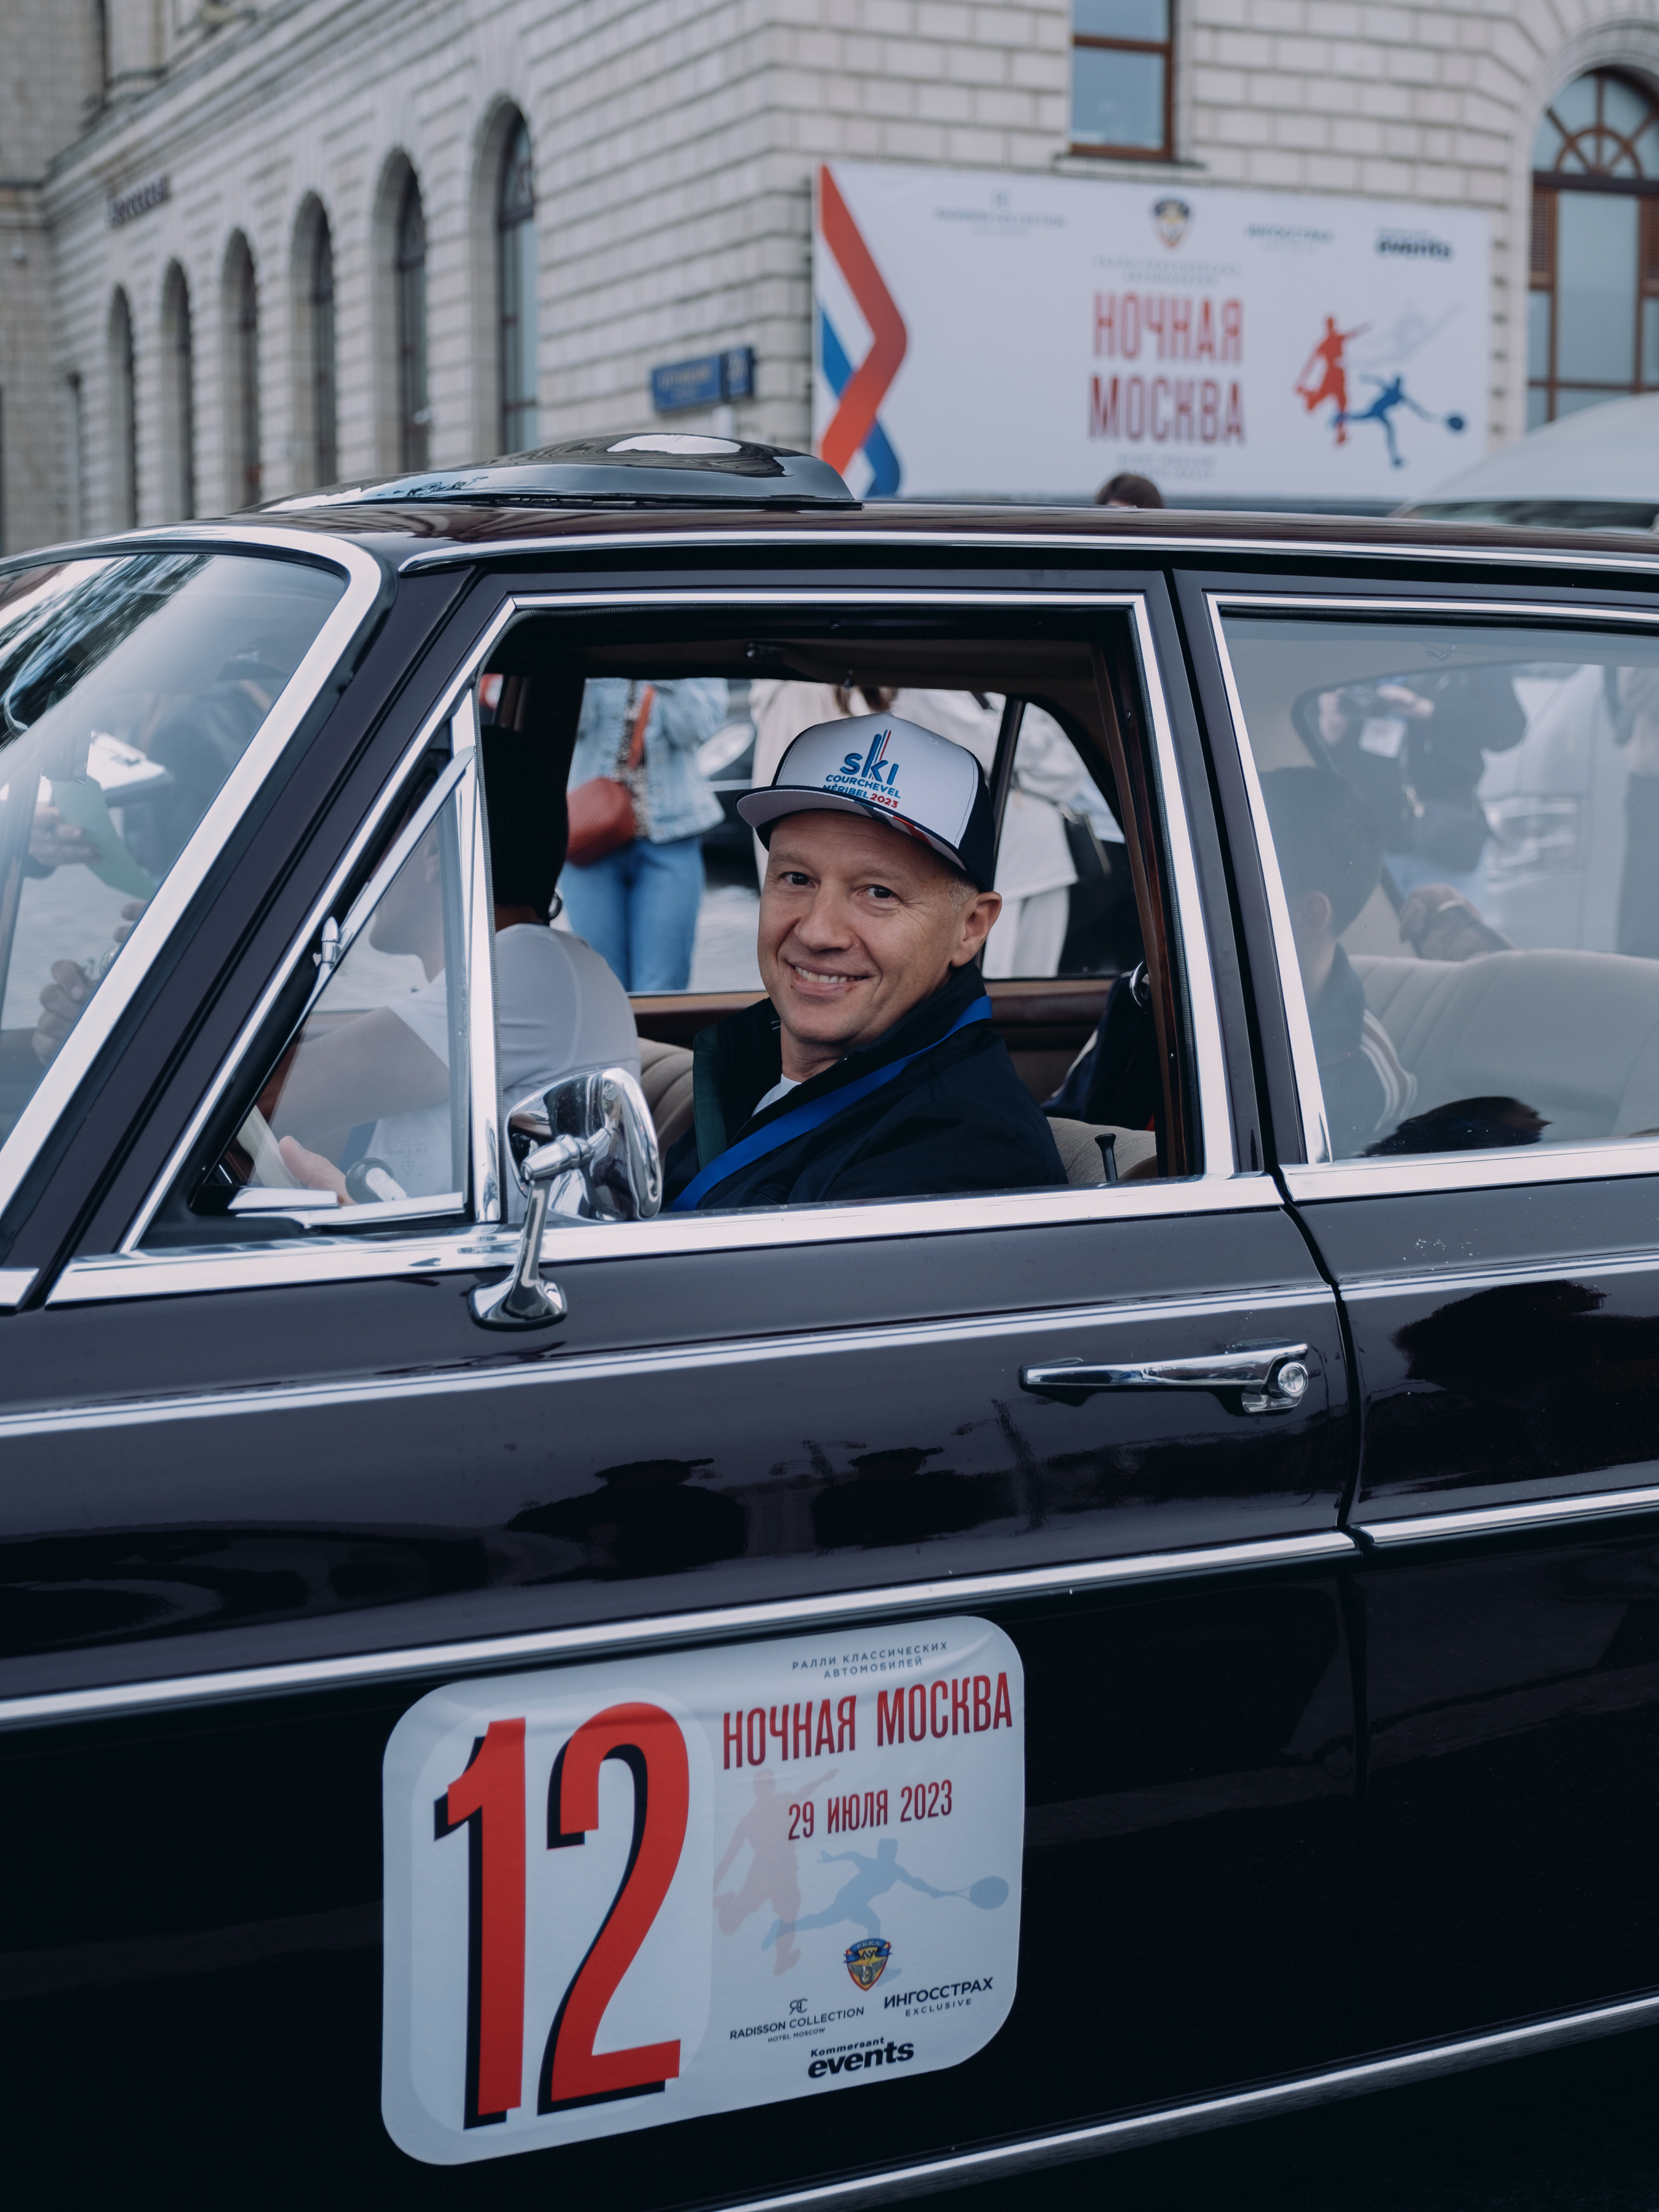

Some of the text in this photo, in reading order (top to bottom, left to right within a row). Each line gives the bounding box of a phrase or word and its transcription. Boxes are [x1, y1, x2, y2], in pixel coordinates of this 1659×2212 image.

[1094, 293, 1242, 363] НОЧНАЯ
[1089, 375, 1245, 443] МОСКВА
[826, 774, 901, 798] COURCHEVEL
[870, 793, 898, 808] 2023
[792, 1641, 948, 1670] РАЛЛИ КЛАССИЧЕСКИХ
[824, 1657, 923, 1679] АВТОМОБИЛЕЙ
[723, 1672, 1013, 1770] НОЧНАЯ МОСКВА
[788, 1779, 953, 1841] 29 ИЮЛЯ 2023
[433, 1701, 690, 2131] 12
[884, 1977, 994, 2009] ИНГОССТРАХ
[905, 1998, 971, 2017] EXCLUSIVE
[730, 2006, 864, 2040] RADISSON COLLECTION
[767, 2027, 826, 2043] HOTEL MOSCOW
[807, 2042, 915, 2078] events
[810, 2037, 885, 2058] Kommersant
